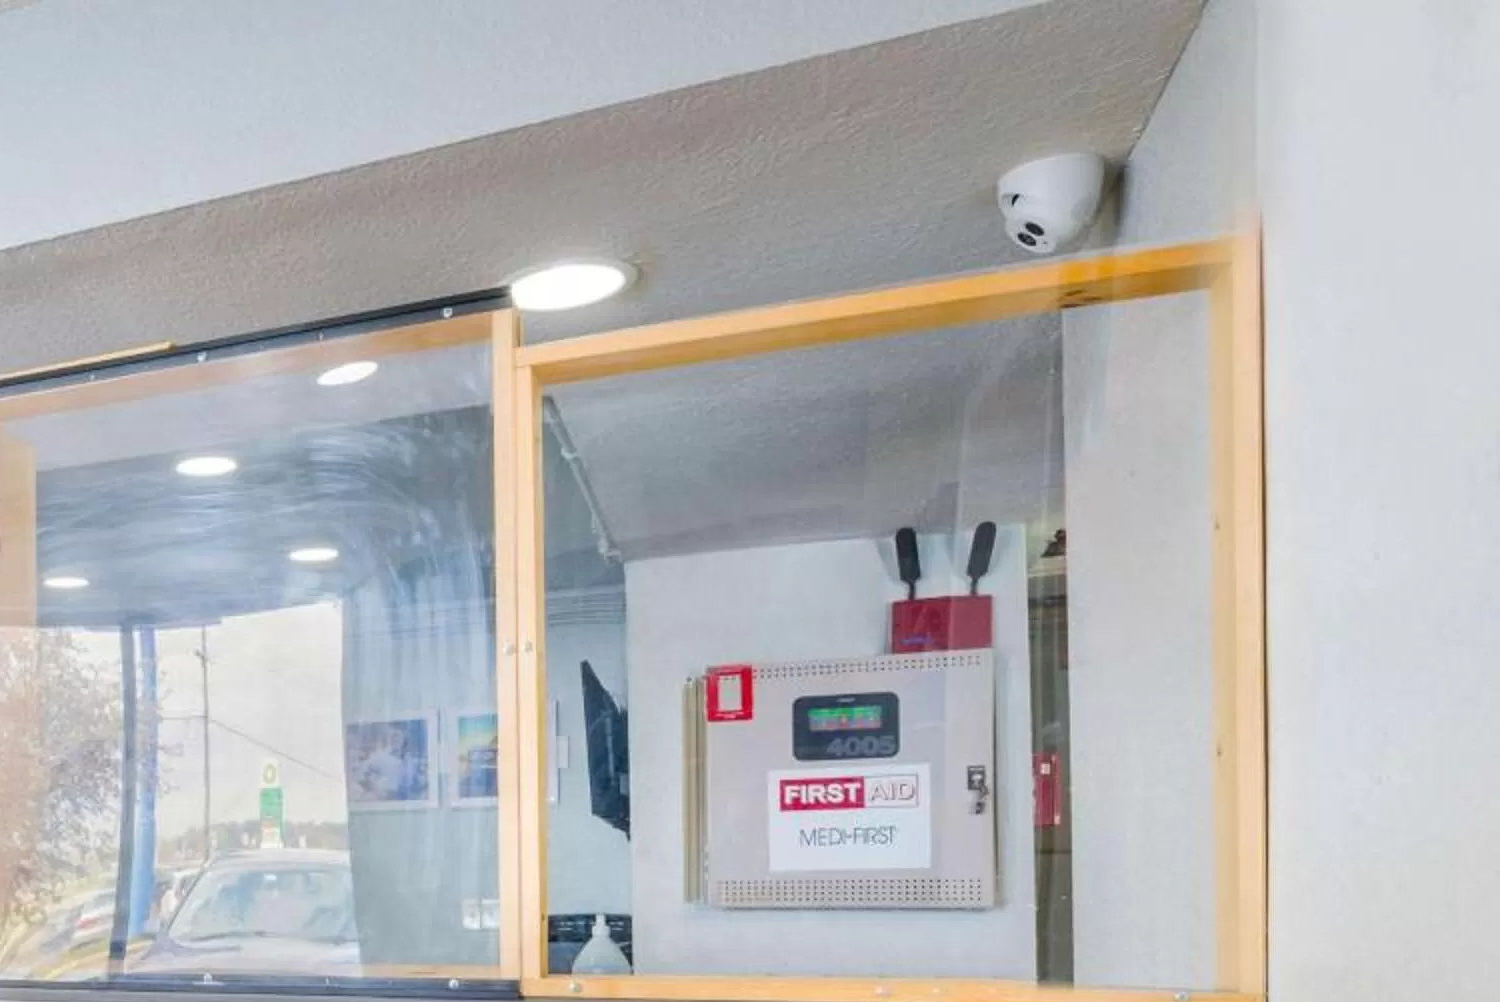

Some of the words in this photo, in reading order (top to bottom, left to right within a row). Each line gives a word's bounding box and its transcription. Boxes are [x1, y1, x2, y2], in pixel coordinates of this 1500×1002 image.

[825, 735, 895, 756] 4005
[784, 782, 861, 805] FIRST
[869, 782, 917, 802] AID
[799, 825, 897, 847] MEDI-FIRST
